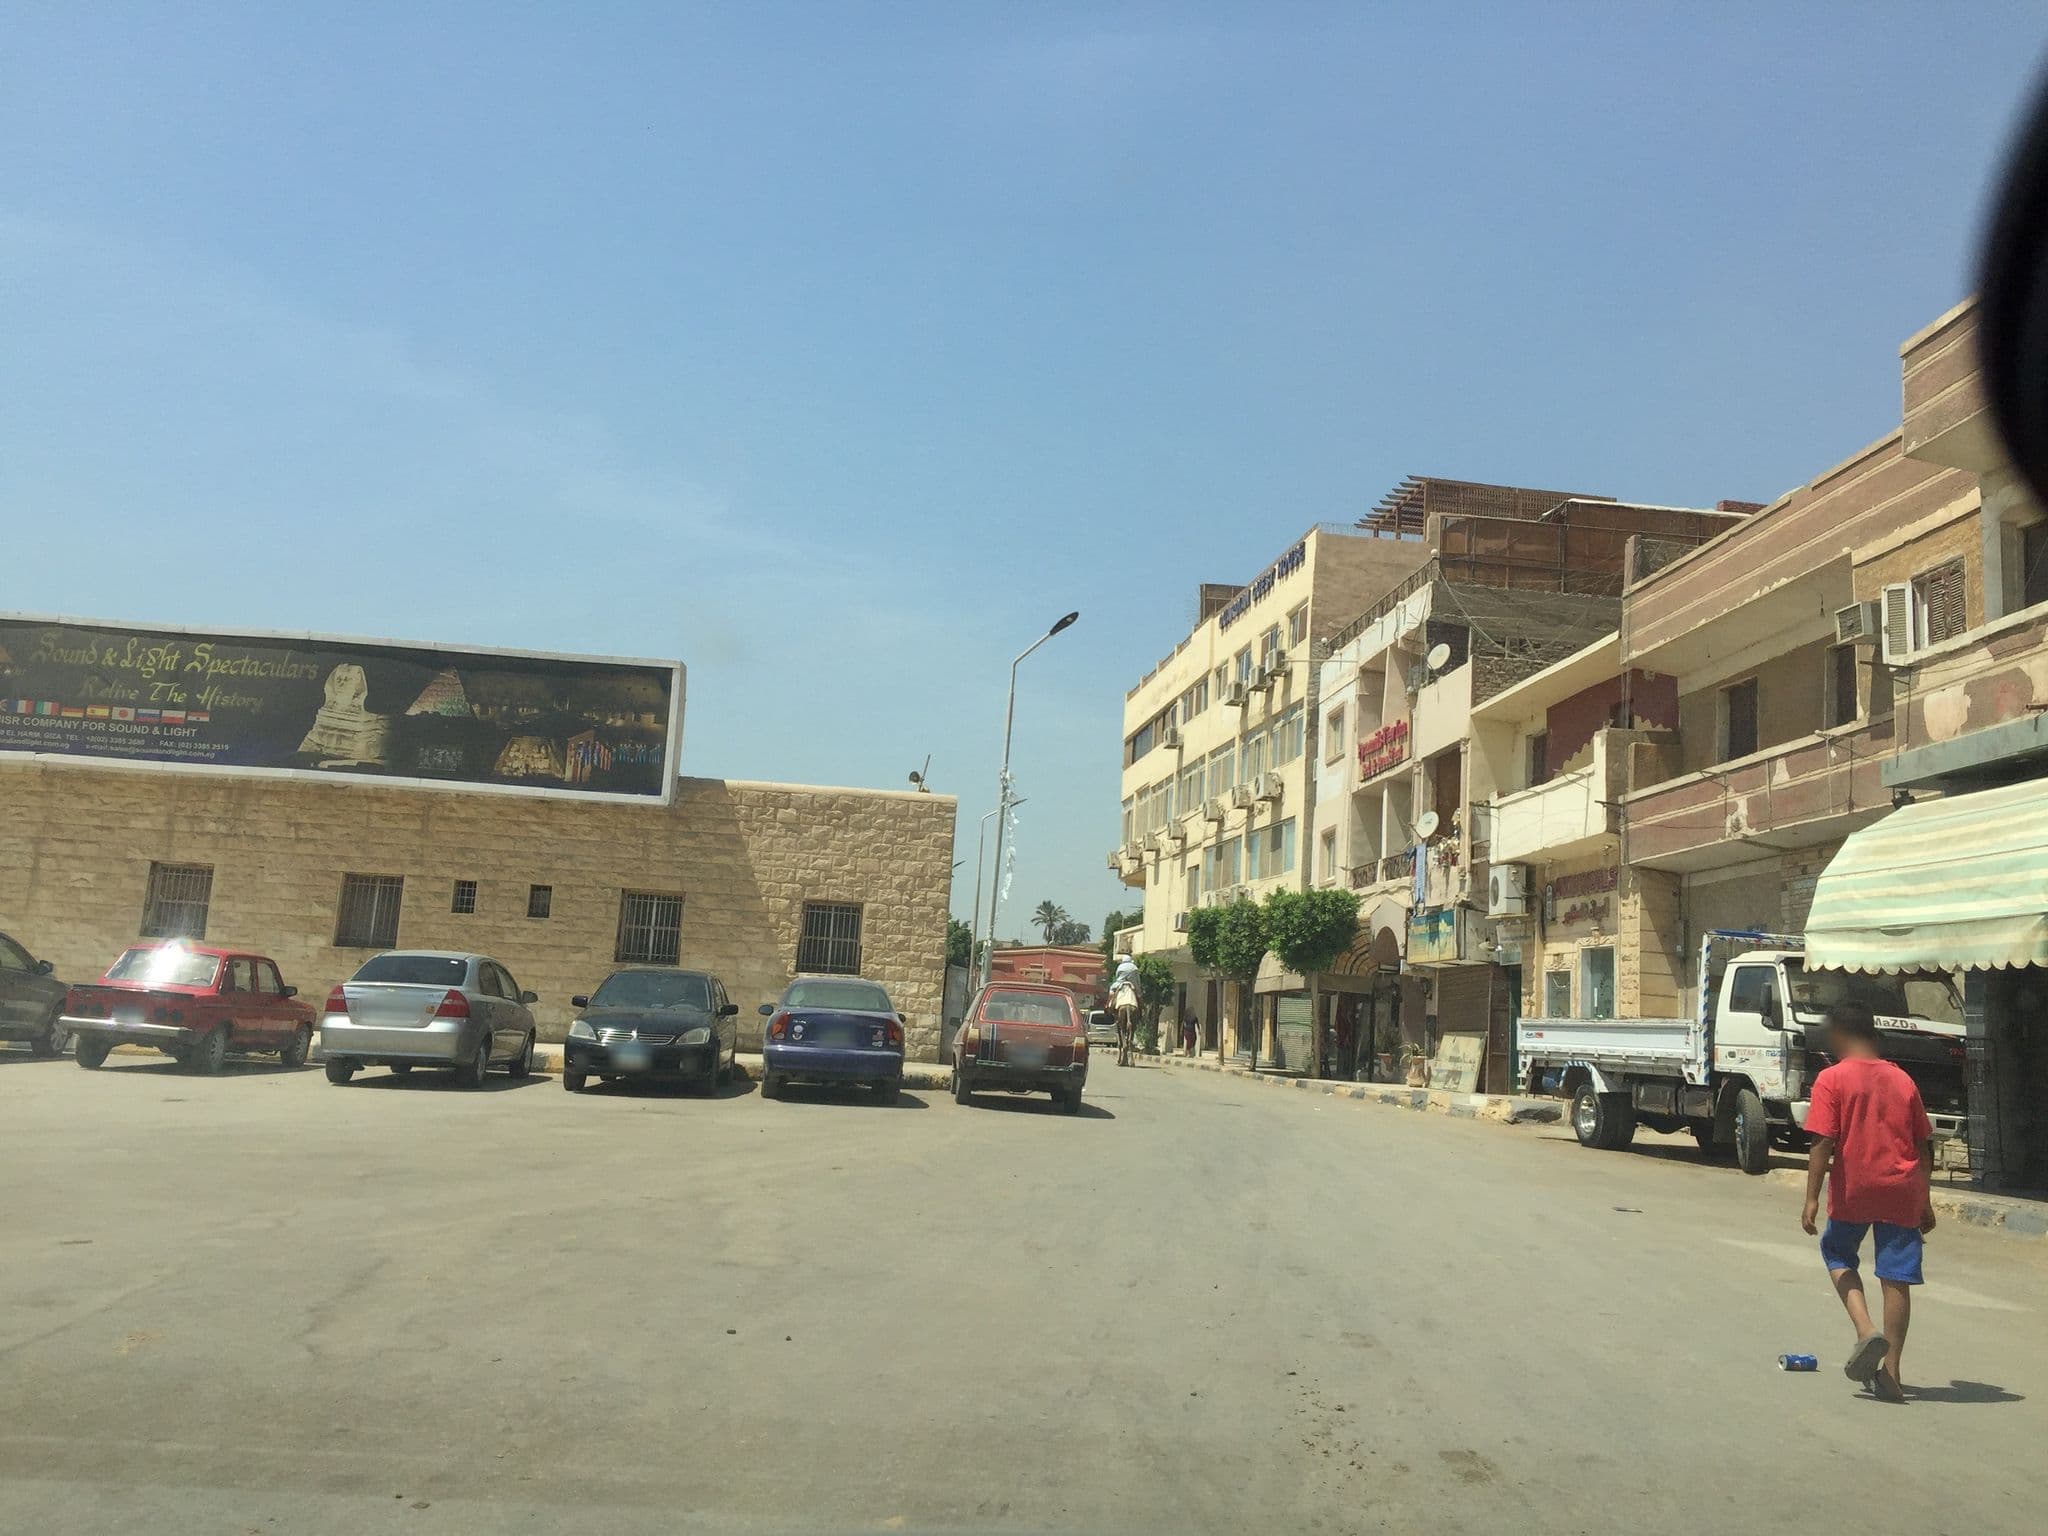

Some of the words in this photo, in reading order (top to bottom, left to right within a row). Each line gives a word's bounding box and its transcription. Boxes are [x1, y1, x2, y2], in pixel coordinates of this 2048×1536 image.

[31, 631, 97, 665] Sound
[102, 647, 118, 666] &
[120, 637, 181, 679] Light
[184, 642, 319, 680] Spectaculars
[149, 681, 188, 703] The
[196, 685, 265, 714] History
[0, 714, 20, 726] ISR
[22, 717, 80, 730] COMPANY
[82, 721, 106, 732] FOR
[108, 723, 150, 735] SOUND
[152, 726, 161, 736] &
[163, 727, 198, 737] LIGHT
